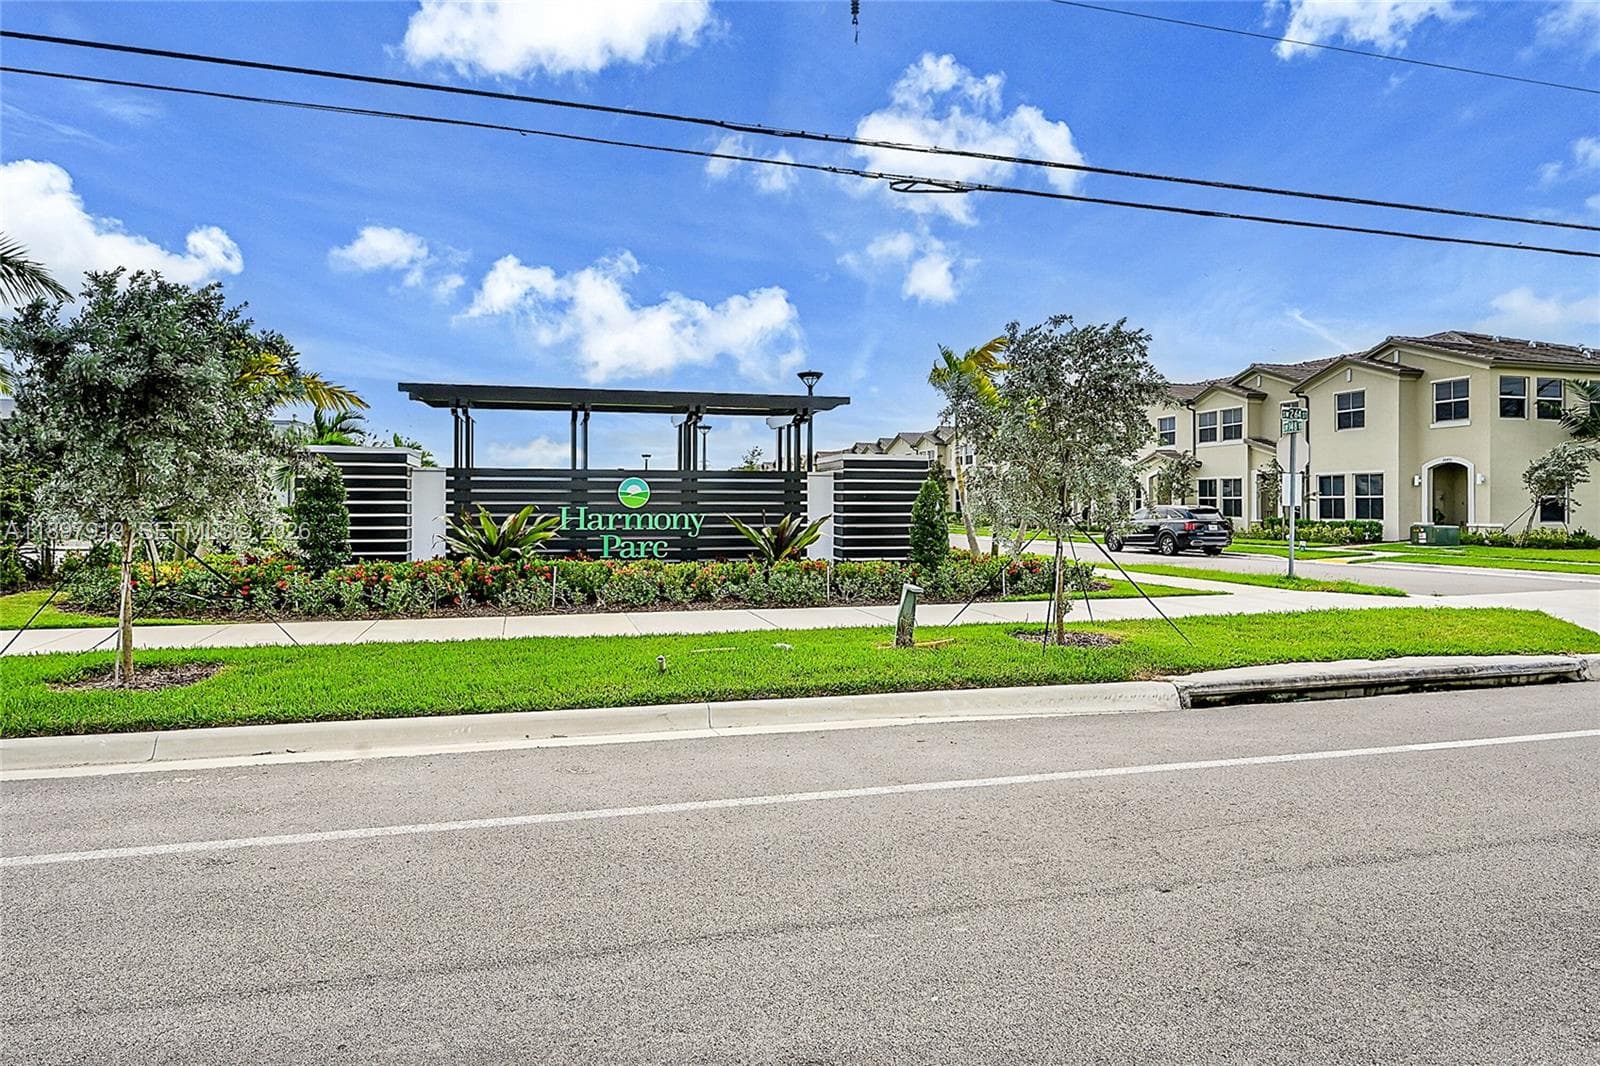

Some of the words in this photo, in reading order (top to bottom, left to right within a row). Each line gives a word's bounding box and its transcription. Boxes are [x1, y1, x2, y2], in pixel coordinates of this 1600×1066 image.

[1289, 409, 1302, 419] 264
[557, 506, 706, 538] Harmony
[599, 534, 669, 559] Parc
